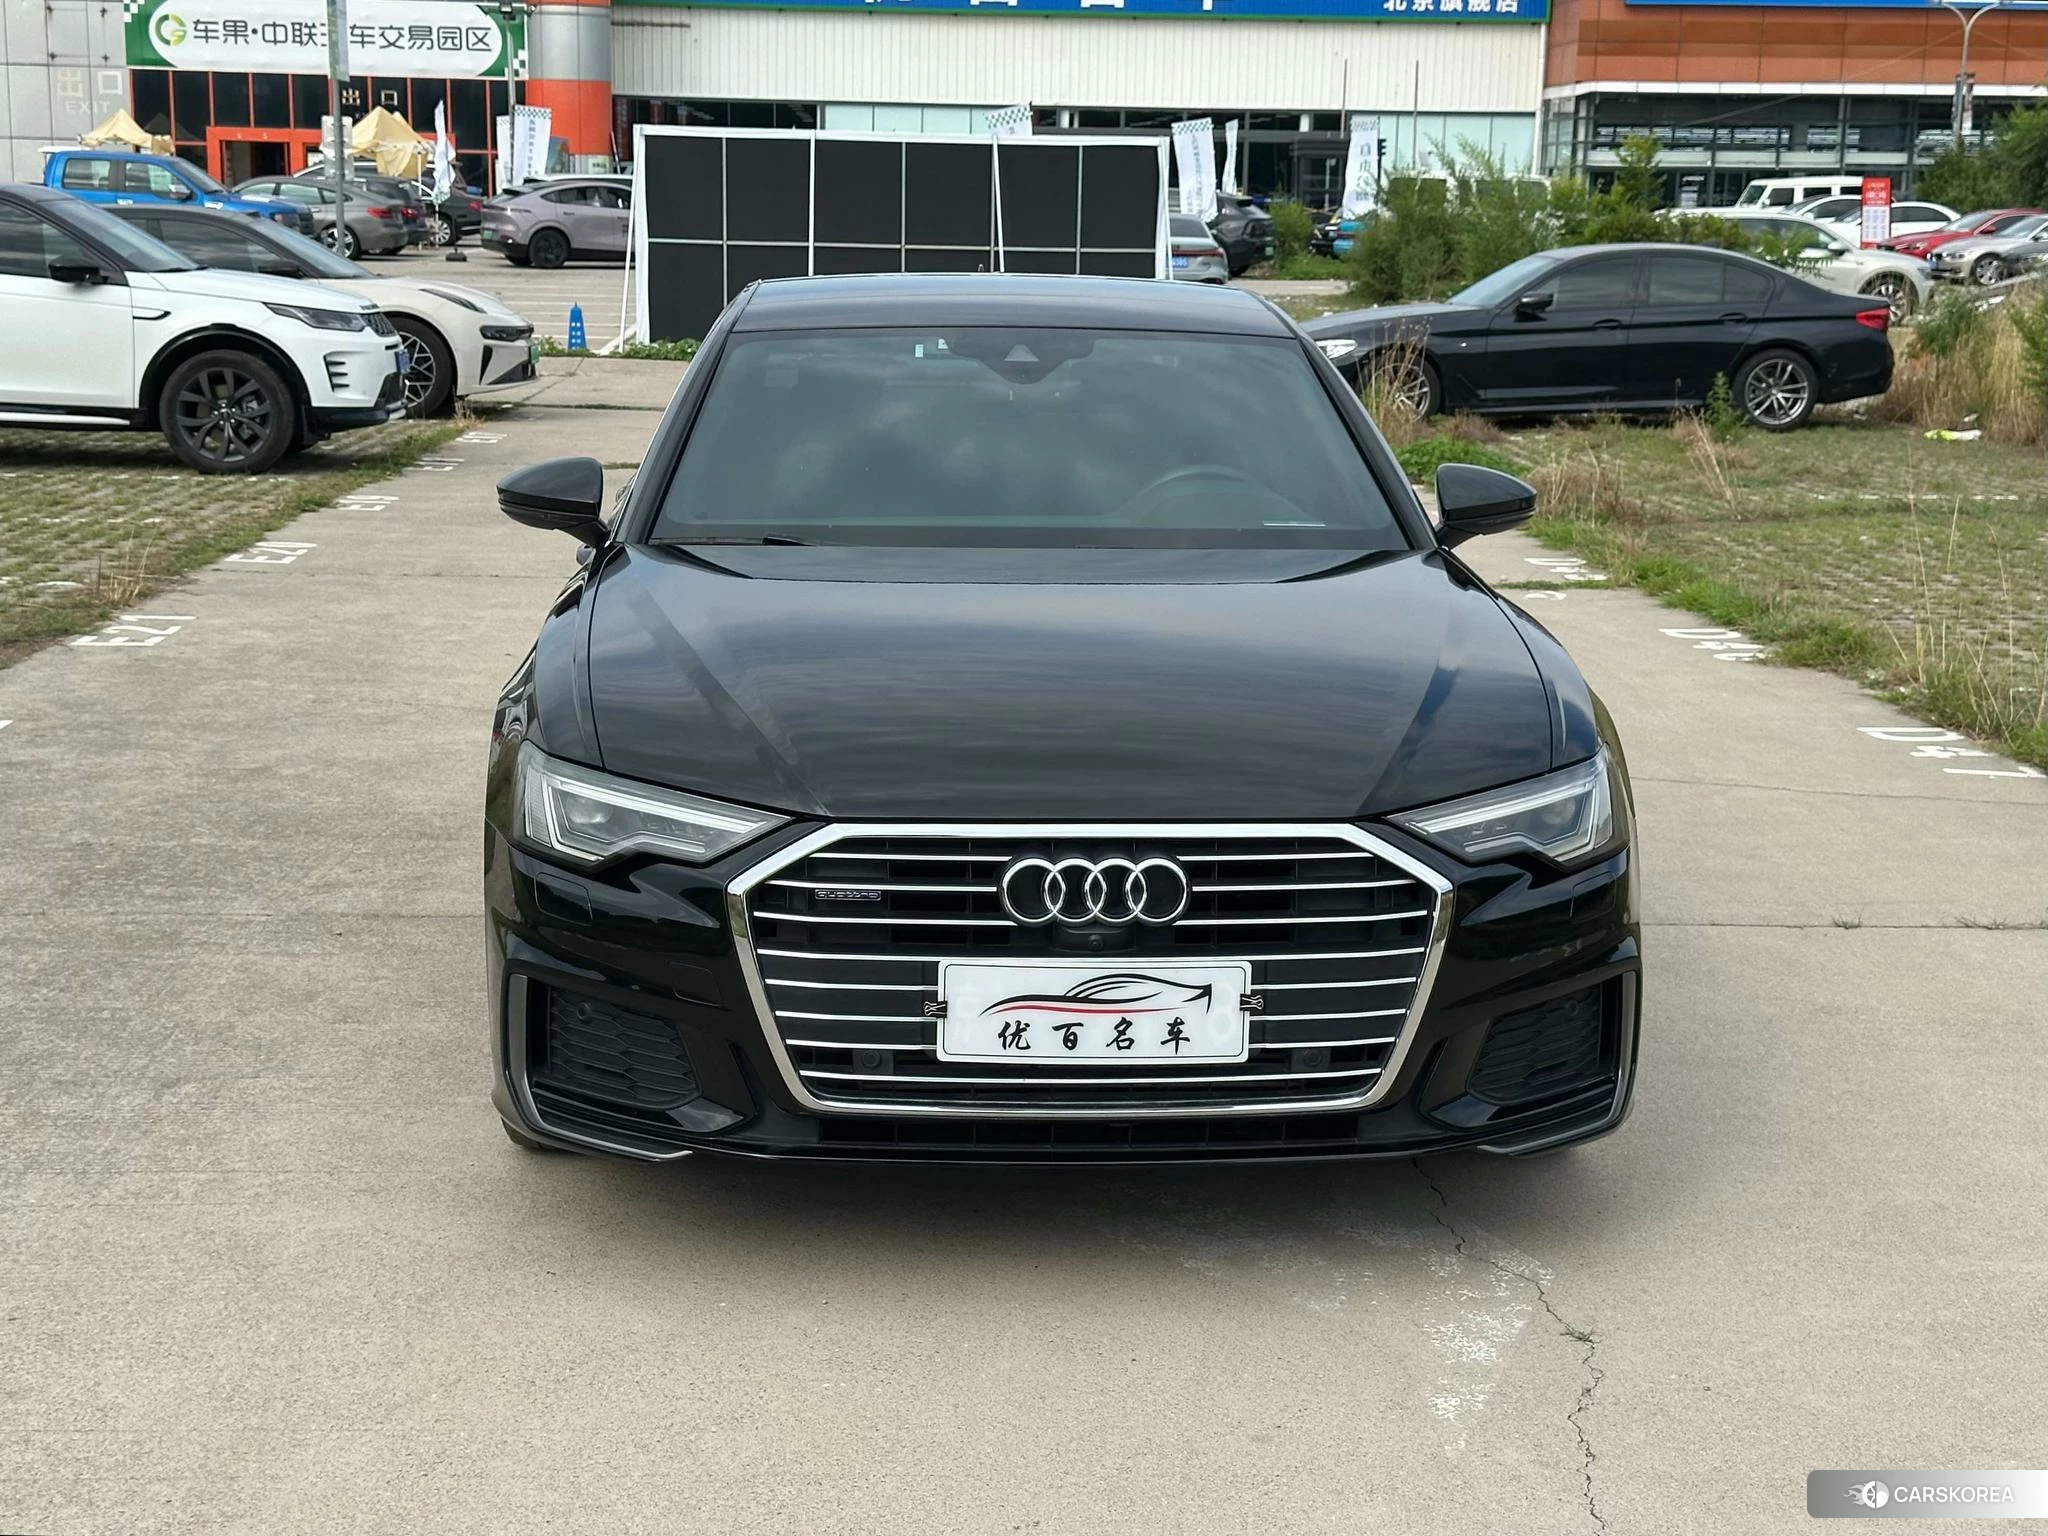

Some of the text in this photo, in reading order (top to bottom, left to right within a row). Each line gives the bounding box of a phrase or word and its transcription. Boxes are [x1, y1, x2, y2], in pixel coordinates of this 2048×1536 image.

[192, 18, 492, 52] 车果·中联车交易园区
[65, 100, 110, 114] EXIT
[224, 541, 318, 564] E20
[69, 615, 198, 647] E21
[998, 1017, 1191, 1054] 优百名车
